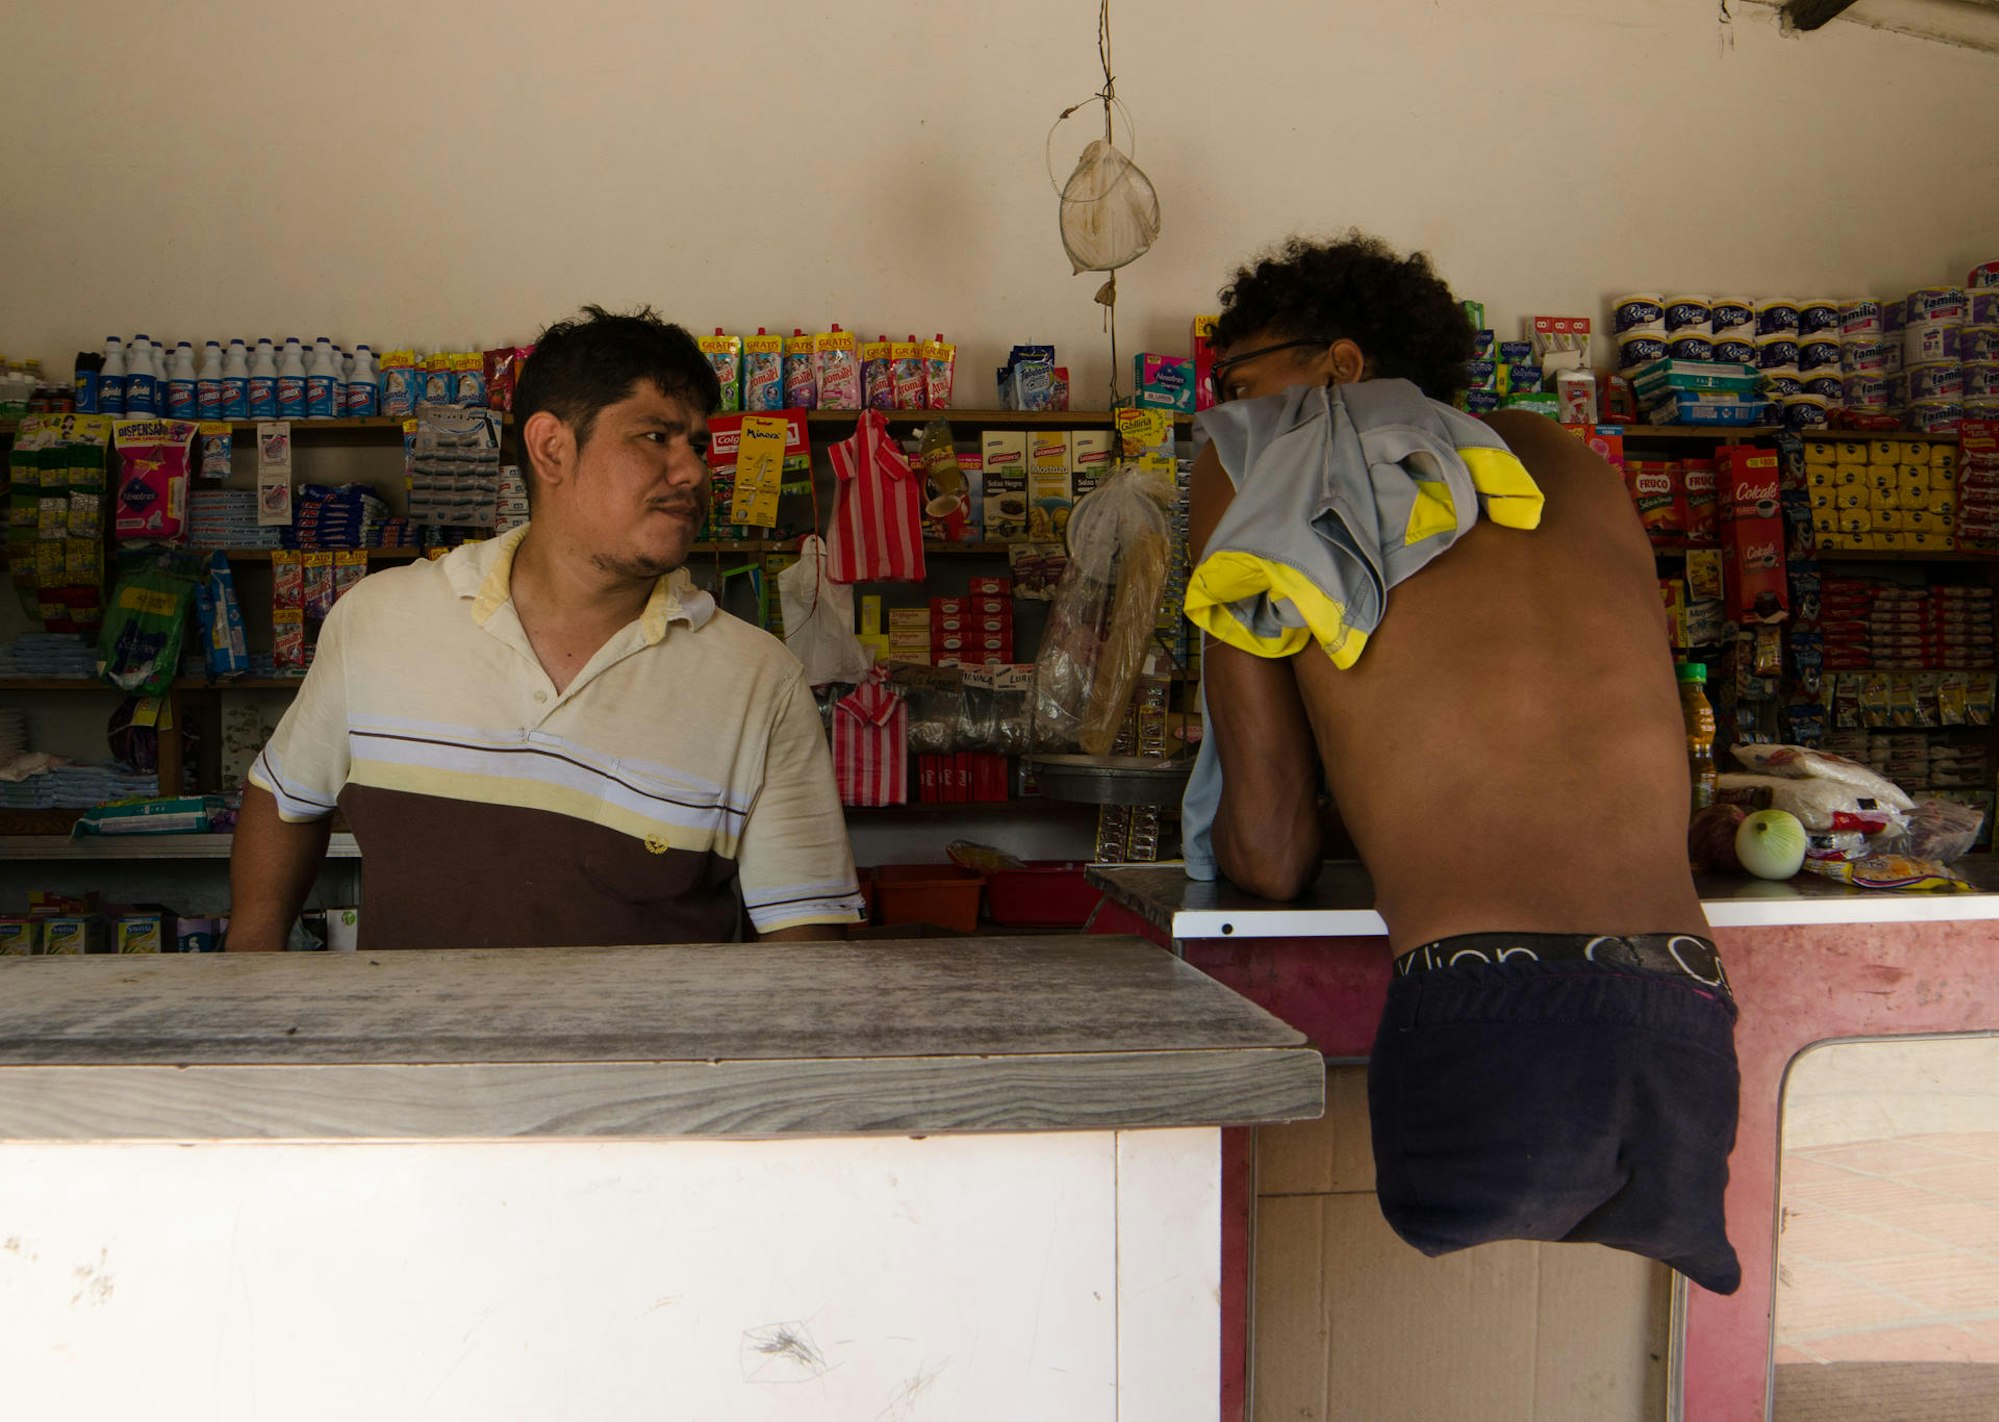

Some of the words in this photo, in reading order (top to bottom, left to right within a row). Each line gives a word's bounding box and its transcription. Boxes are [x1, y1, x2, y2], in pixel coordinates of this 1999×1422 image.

[747, 341, 779, 350] GRATIS
[819, 338, 852, 350] GRATIS
[747, 429, 778, 440] Minora
[1031, 465, 1068, 475] Mostaza
[1640, 480, 1668, 489] FRUCO
